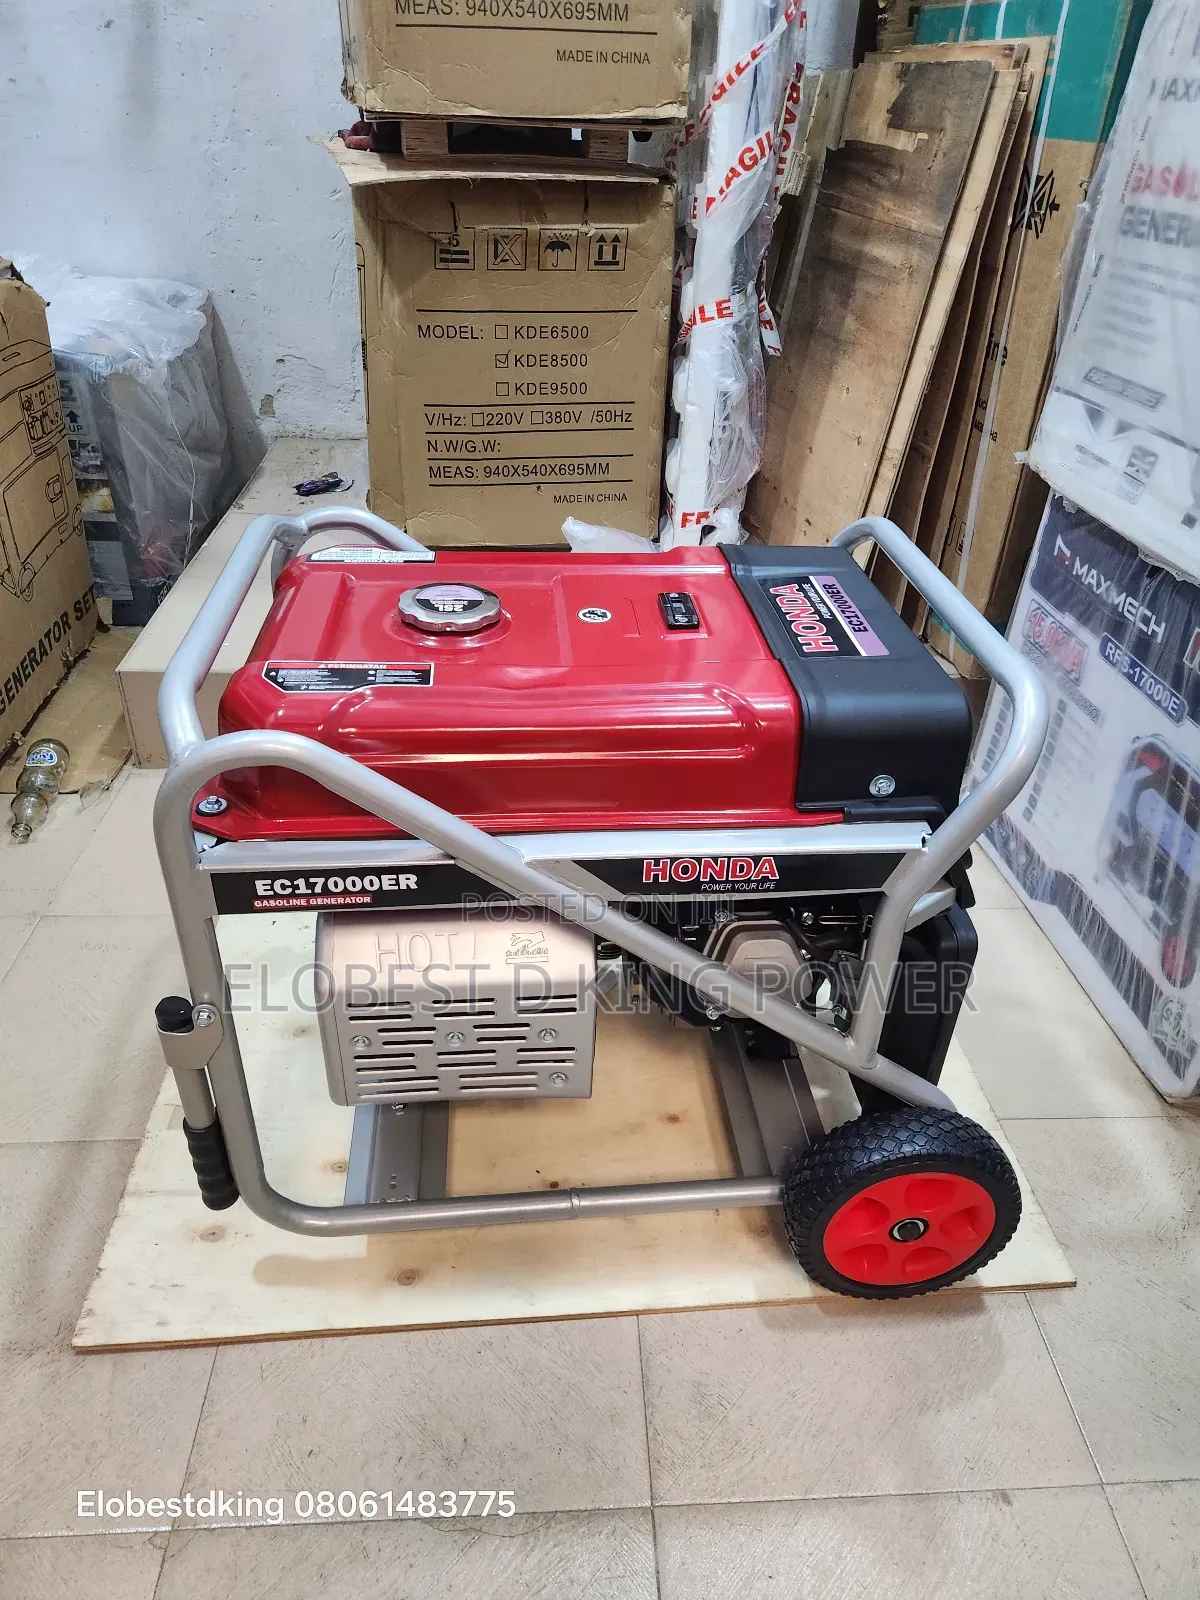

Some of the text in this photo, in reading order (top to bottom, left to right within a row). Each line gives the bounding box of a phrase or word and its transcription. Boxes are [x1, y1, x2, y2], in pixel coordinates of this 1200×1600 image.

[395, 0, 629, 22] MEAS: 940X540X695MM
[556, 49, 651, 65] MADE IN CHINA
[417, 325, 590, 340] MODEL: KDE6500
[514, 353, 588, 368] KDE8500
[514, 381, 588, 396] KDE9500
[425, 409, 633, 427] V/Hz: 220V 380V /50Hz
[427, 439, 501, 453] N.W/G.W:
[429, 462, 610, 479] MEAS: 940X540X695MM
[553, 493, 628, 503] MADE IN CHINA
[822, 583, 869, 633] EC17000ER
[769, 583, 840, 652] HONDA
[0, 611, 72, 716] GENERATOR
[74, 584, 98, 622] SET
[643, 856, 780, 883] HONDA
[254, 874, 419, 896] EC17000ER
[701, 882, 777, 891] POWER YOUR LIFE
[254, 896, 371, 907] GASOLINE GENERATOR
